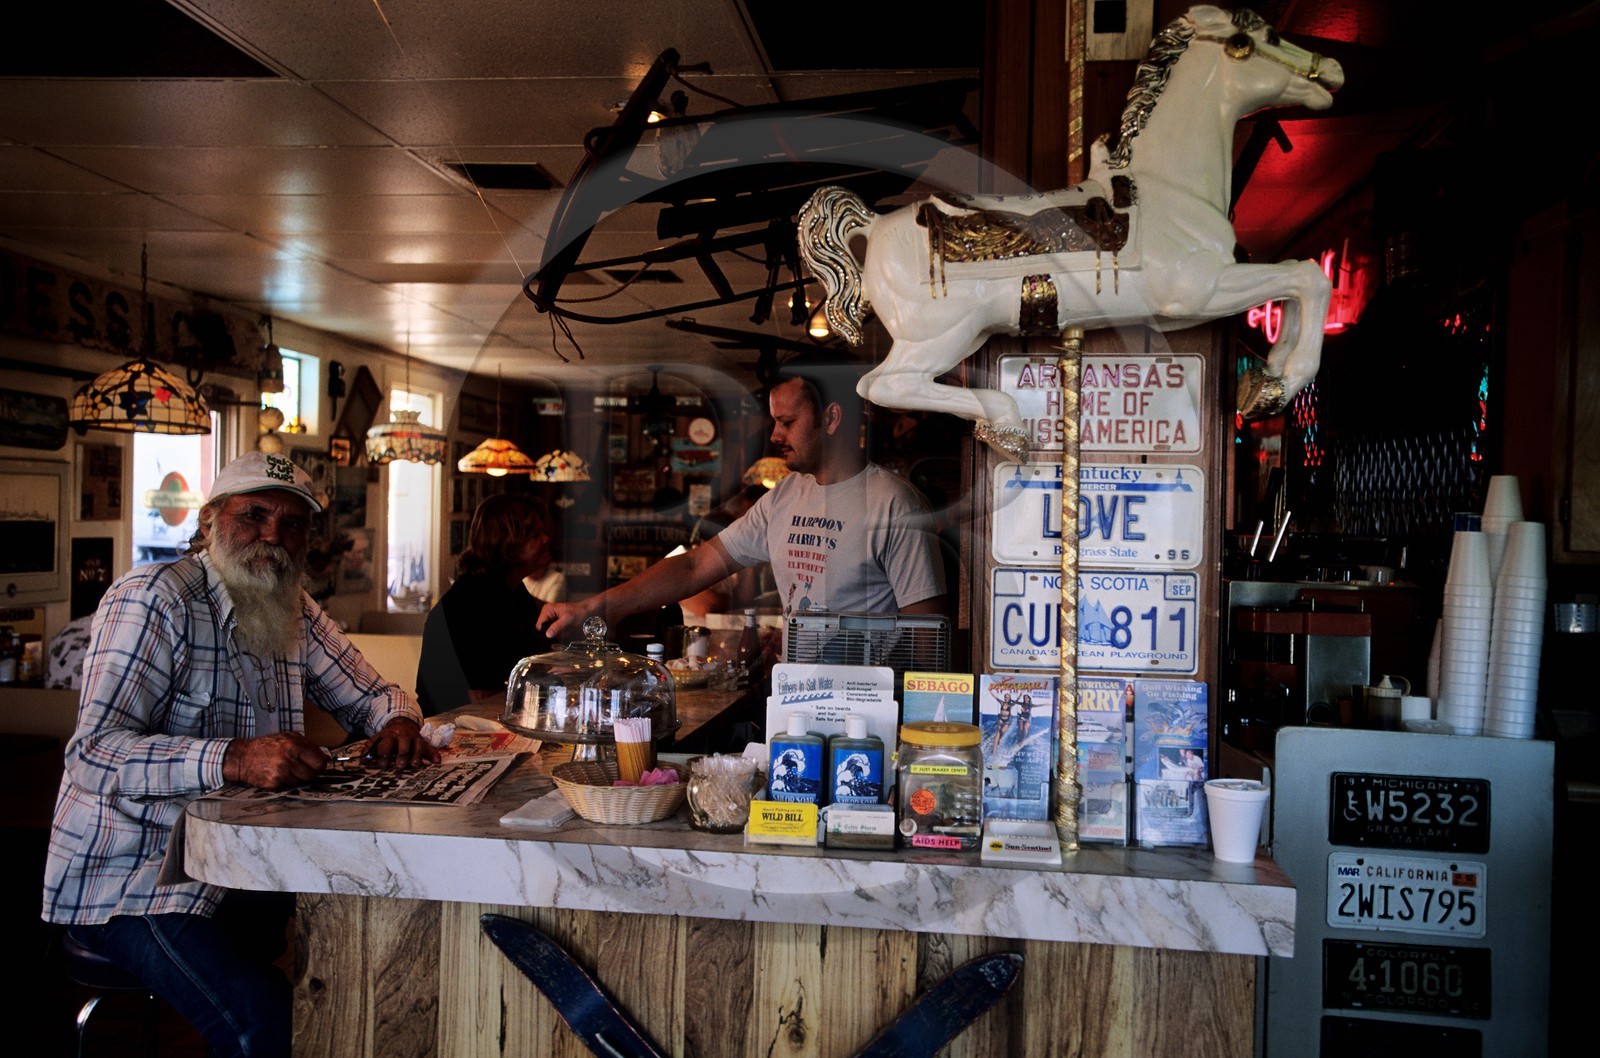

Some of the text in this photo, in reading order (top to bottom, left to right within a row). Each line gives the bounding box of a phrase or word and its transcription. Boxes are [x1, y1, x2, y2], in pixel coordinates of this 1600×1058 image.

[1017, 363, 1184, 389] ARANSAS
[1046, 391, 1154, 417] HME OF
[1027, 418, 1187, 445] ISS AMERICA
[1054, 464, 1142, 483] Kntucky
[1079, 483, 1117, 491] MERCER
[791, 515, 846, 532] HARPOON
[787, 533, 838, 550] HARRY'S
[811, 551, 828, 563] THE
[1053, 545, 1191, 561] Bgrass State 96
[97, 568, 107, 583] 7
[1042, 575, 1150, 592] NOA SCOTIA
[1172, 584, 1191, 596] SEP
[1110, 605, 1186, 652] 811
[1000, 647, 1189, 661] CANADA'S CEAN PLAYGROUND
[778, 677, 834, 695] Lathers In Salt Water
[906, 679, 971, 693] SEBAGO
[1077, 682, 1119, 690] TORTUGAS
[1142, 683, 1202, 694] Quit Wishing
[1076, 690, 1124, 712] ERRY
[1162, 692, 1198, 700] Fishing
[1372, 778, 1449, 790] MICHIGAN
[1365, 789, 1480, 827] W5232
[762, 812, 804, 822] WILD BILL
[1366, 824, 1409, 834] GREAT
[915, 836, 960, 847] AIDS HELP
[1005, 842, 1052, 852] Sun-Sentinel
[1337, 866, 1360, 877] MAR
[1366, 866, 1448, 881] CALIFORNIA
[1337, 883, 1476, 926] 2WIS795
